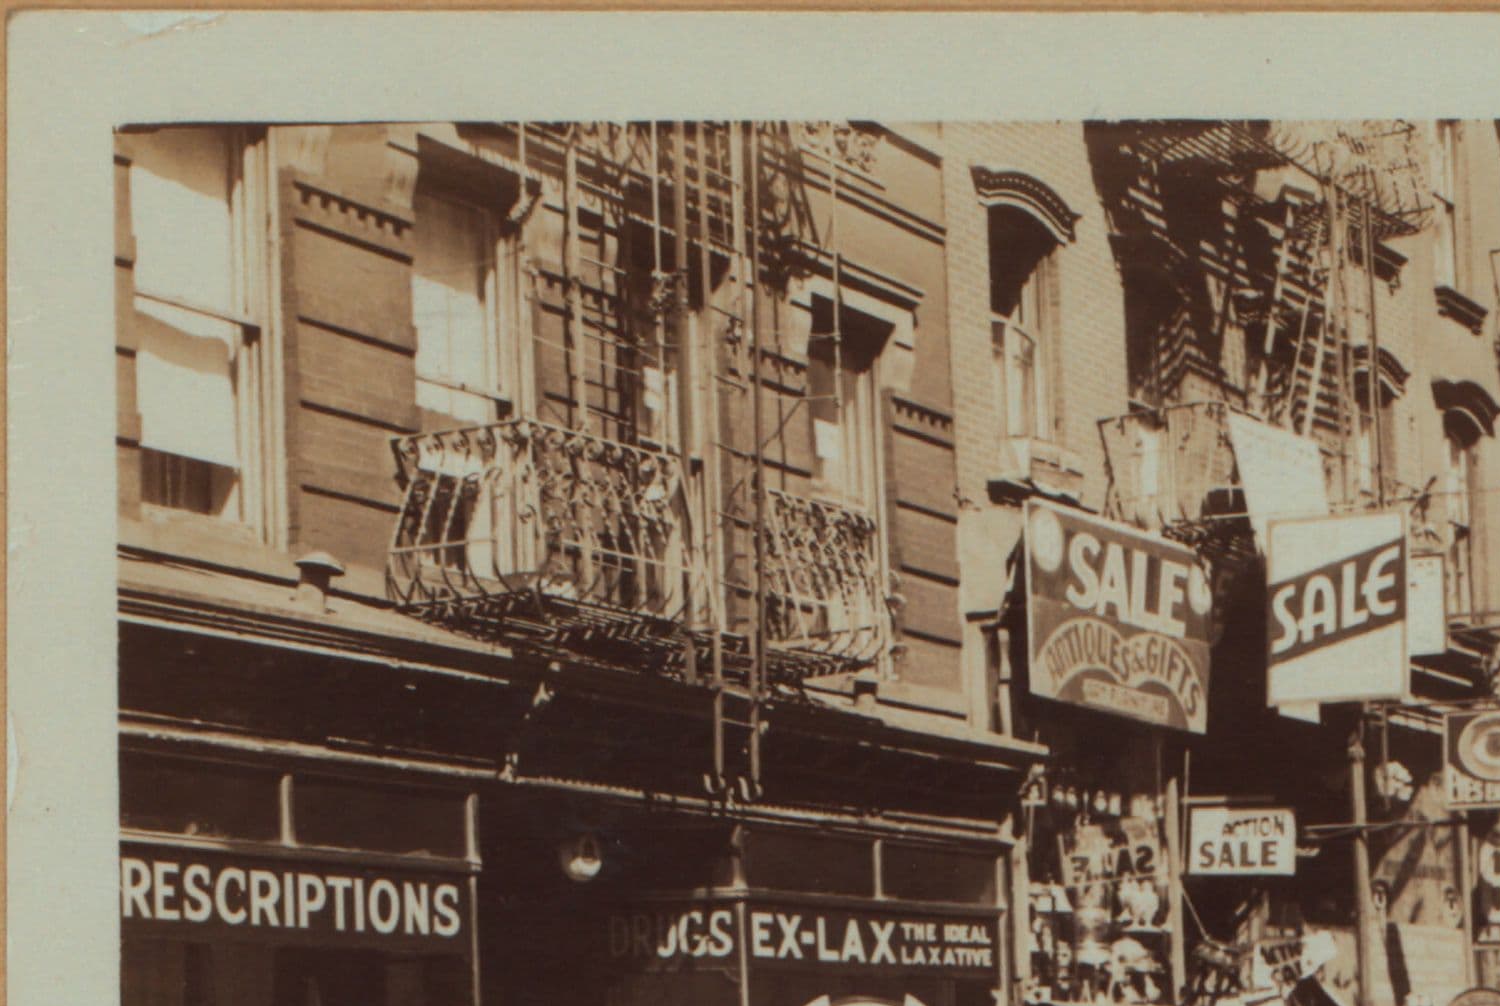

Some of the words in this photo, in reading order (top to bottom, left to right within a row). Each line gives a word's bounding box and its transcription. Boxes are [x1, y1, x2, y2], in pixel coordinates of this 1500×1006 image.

[1065, 532, 1188, 638] SALE
[1271, 544, 1400, 655] SALE
[1146, 637, 1200, 718] GIFTS
[1199, 841, 1278, 868] SALE
[120, 857, 461, 937] RESCRIPTIONS
[611, 911, 733, 959] DRUGS
[752, 912, 897, 964] EX-LAX
[901, 924, 938, 944] THE
[944, 923, 993, 945] IDEAL
[901, 947, 994, 968] LAXATIVE
